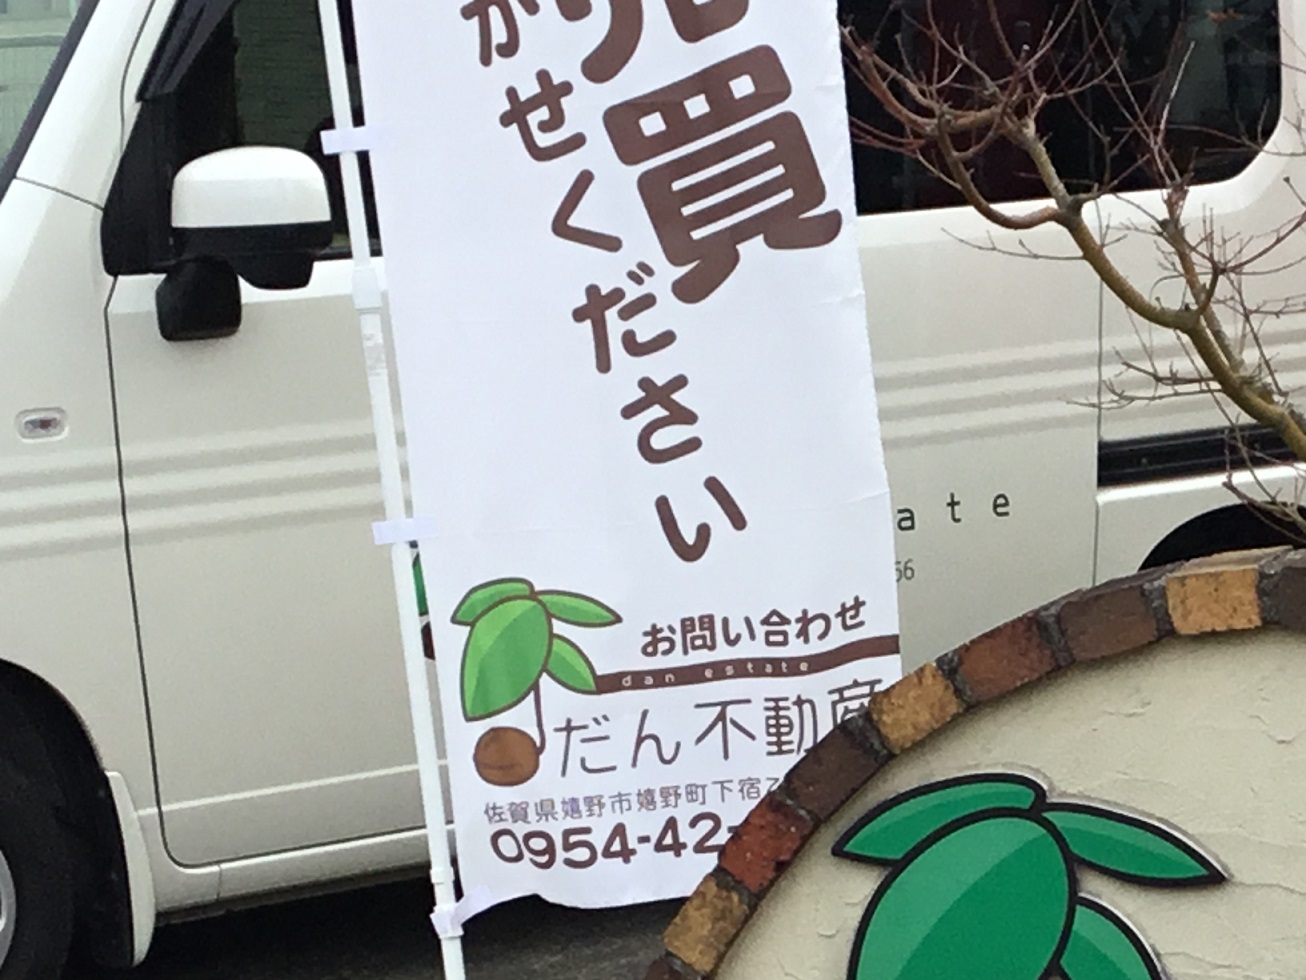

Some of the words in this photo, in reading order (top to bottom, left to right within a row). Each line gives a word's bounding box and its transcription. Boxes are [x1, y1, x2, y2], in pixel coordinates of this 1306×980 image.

[640, 594, 867, 658] お問い合わせ
[621, 671, 676, 688] dan
[704, 660, 810, 679] estate
